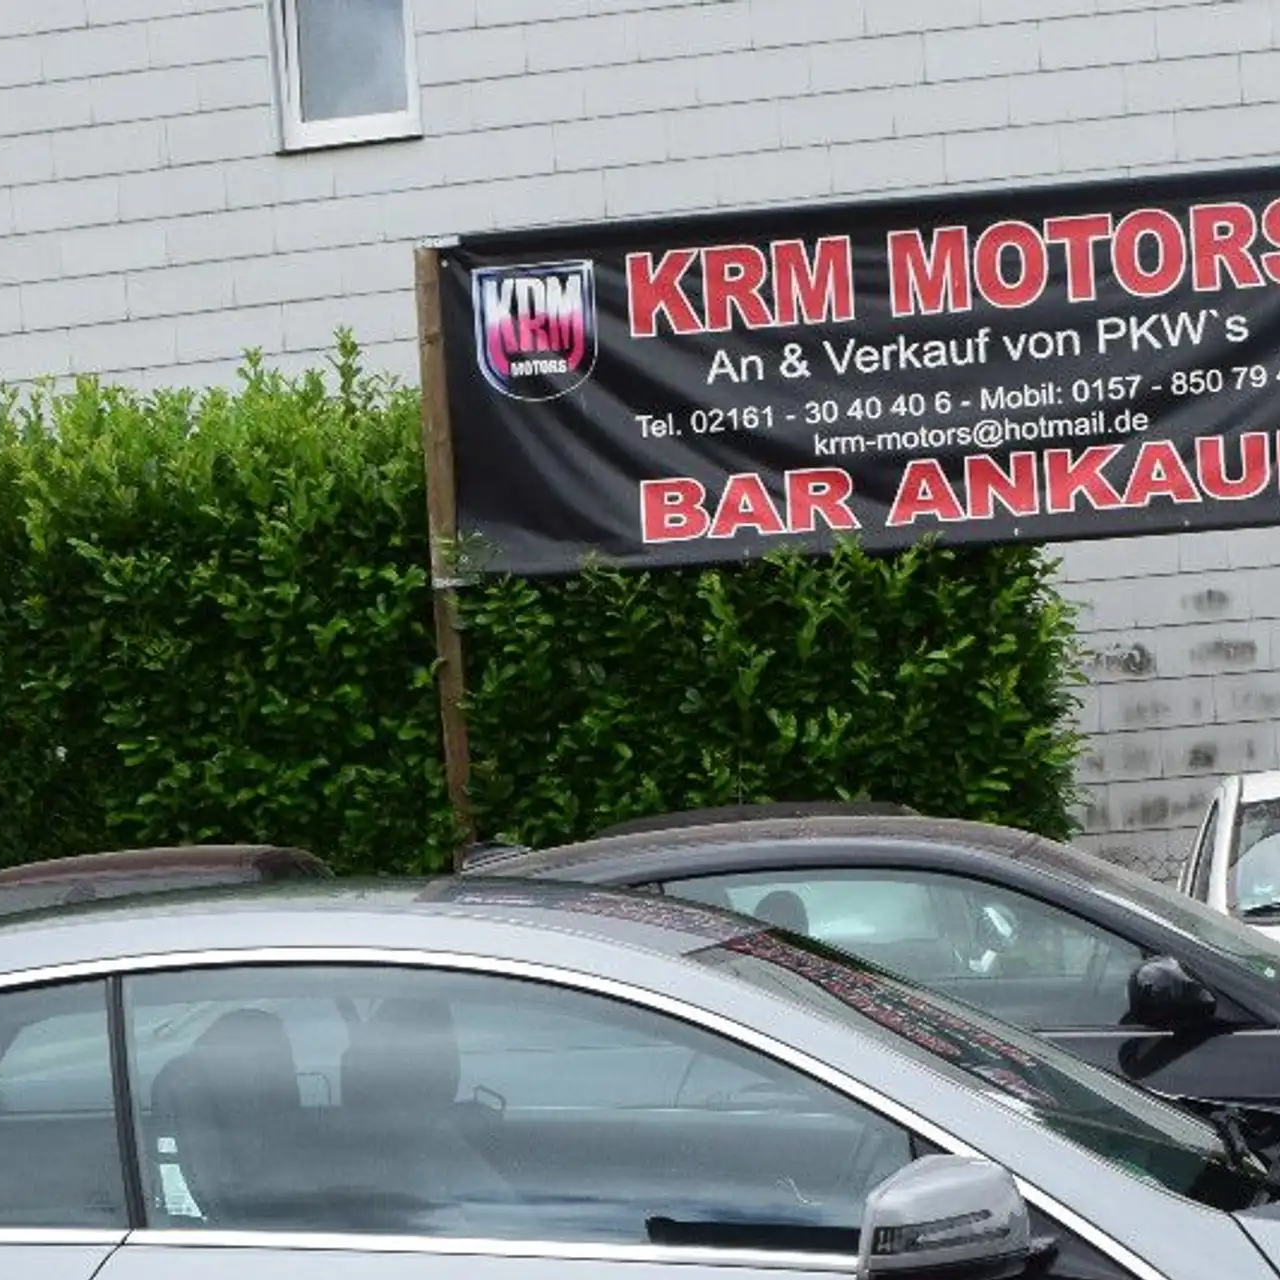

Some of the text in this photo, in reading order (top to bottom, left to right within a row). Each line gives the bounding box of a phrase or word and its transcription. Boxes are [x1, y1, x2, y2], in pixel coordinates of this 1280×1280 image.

[626, 235, 855, 338] KRM
[483, 275, 586, 377] KRM
[706, 348, 764, 384] An
[779, 343, 811, 378] &
[822, 327, 990, 376] Verkauf
[1003, 326, 1081, 361] von
[511, 359, 568, 377] MOTORS
[635, 414, 682, 438] Tel.
[690, 405, 774, 434] 02161
[805, 400, 838, 425] 30
[846, 396, 881, 420] 40
[889, 393, 924, 417] 40
[934, 391, 951, 414] 6
[980, 382, 1062, 411] Mobil:
[1071, 375, 1142, 403] 0157
[1171, 369, 1222, 395] 850
[1231, 364, 1268, 391] 79
[814, 409, 1149, 456] krm-motors@hotmail.de
[640, 468, 862, 544] BAR
